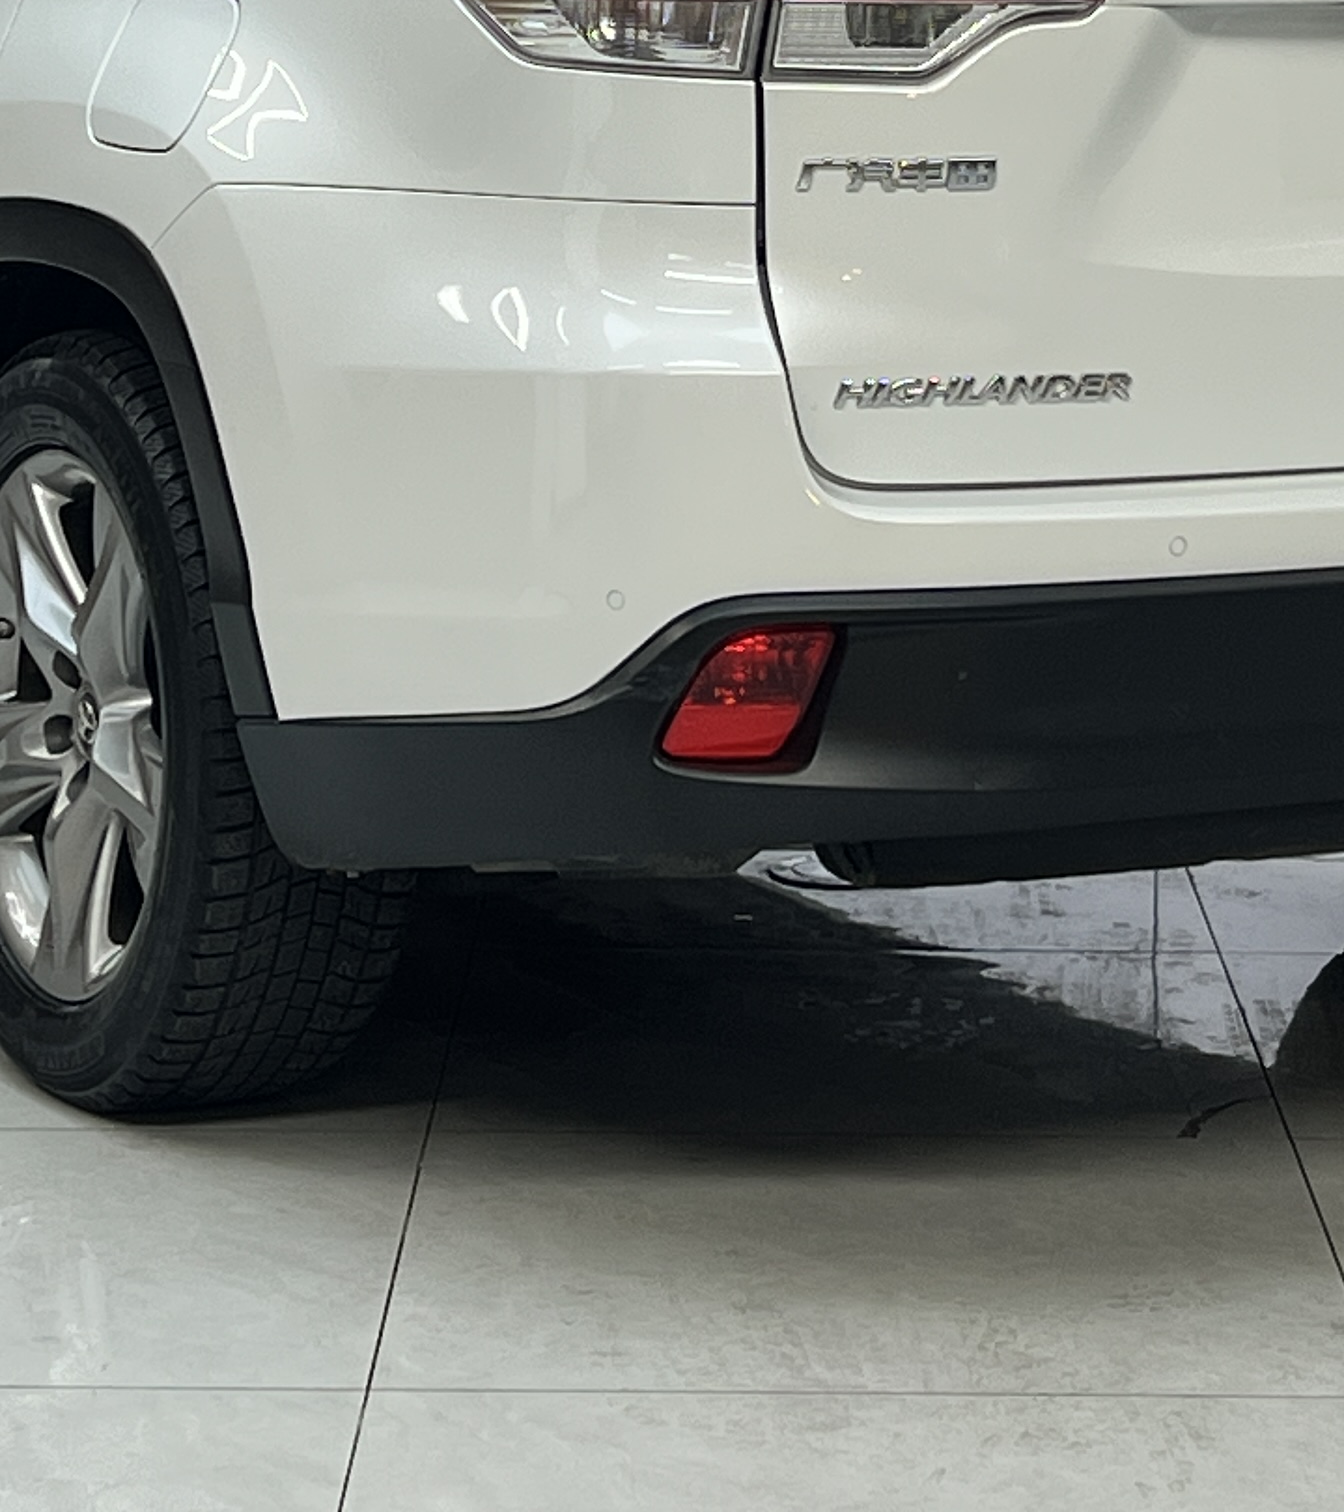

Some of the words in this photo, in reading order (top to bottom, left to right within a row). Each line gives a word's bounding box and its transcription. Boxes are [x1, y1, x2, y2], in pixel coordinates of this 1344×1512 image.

[795, 155, 997, 192] 广汽丰田
[833, 371, 1133, 410] HIGHLANDER
